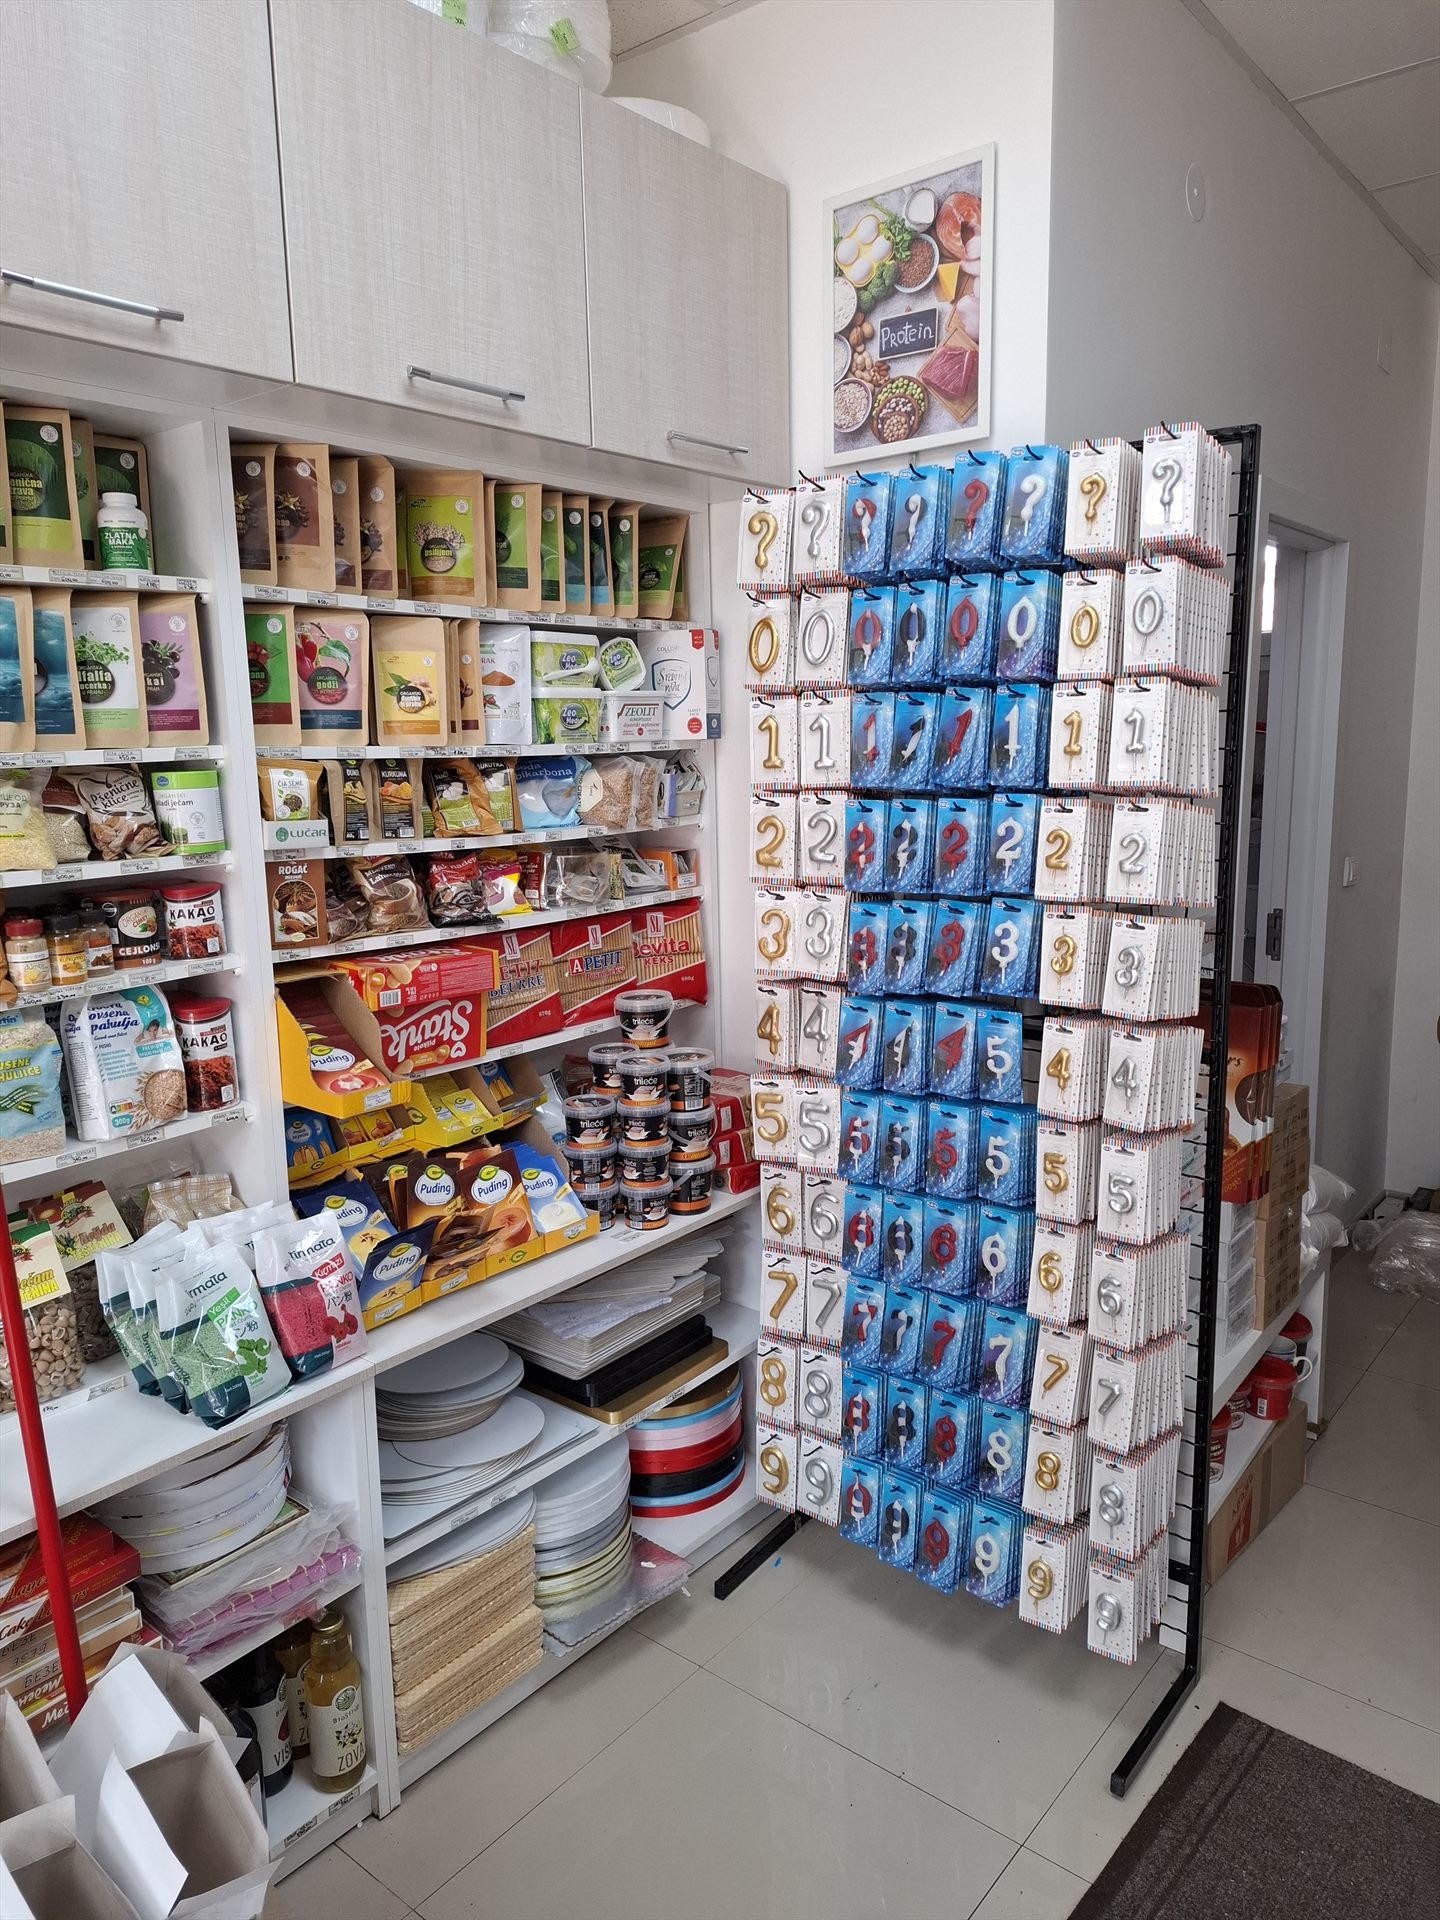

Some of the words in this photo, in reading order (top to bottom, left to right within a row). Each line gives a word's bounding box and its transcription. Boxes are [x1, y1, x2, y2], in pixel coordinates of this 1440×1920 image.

[104, 532, 138, 541] ZLATNA
[1007, 598, 1037, 648] 0
[1071, 604, 1099, 649] 0
[1133, 588, 1164, 635] 0
[561, 653, 577, 663] Zeo
[750, 616, 780, 673] 0
[802, 610, 835, 666] 0
[562, 708, 577, 718] Zeo
[624, 706, 658, 717] ZEOLIT
[1004, 704, 1022, 754] 1
[1124, 707, 1146, 754] 1
[758, 714, 783, 769] 1
[809, 713, 835, 769] 1
[1063, 710, 1082, 755] 1
[90, 779, 140, 806] Pšenične
[101, 793, 129, 810] klice
[756, 816, 785, 867] 2
[808, 811, 837, 863] 2
[996, 818, 1025, 860] 2
[1045, 827, 1071, 870] 2
[1119, 833, 1147, 874] 2
[278, 863, 309, 875] ROGAČ
[169, 905, 216, 921] KAKAO
[649, 914, 663, 934] SL
[806, 906, 834, 959] 3
[505, 936, 519, 955] SL
[589, 926, 600, 946] SL
[758, 908, 790, 960] 3
[992, 921, 1019, 962] 3
[1050, 934, 1077, 975] 3
[571, 951, 622, 975] APETIT
[644, 955, 675, 967] KEKS
[1115, 946, 1142, 987] 3
[88, 1009, 130, 1022] ovsena
[90, 1017, 140, 1036] pahulja
[757, 1003, 782, 1054] 4
[804, 1001, 830, 1054] 4
[181, 1032, 228, 1049] KAKAO
[311, 1054, 350, 1068] Puding
[986, 1036, 1013, 1075] 5
[1046, 1048, 1070, 1089] 4
[1112, 1057, 1138, 1098] 4
[755, 1093, 787, 1144] 5
[799, 1101, 831, 1151] 5
[985, 1136, 1011, 1176] 5
[1043, 1152, 1068, 1194] 5
[420, 1183, 452, 1196] Puding
[477, 1178, 508, 1198] Puding
[524, 1177, 554, 1193] Puding
[1108, 1173, 1133, 1214] 5
[766, 1185, 795, 1236] 6
[810, 1191, 839, 1241] 6
[378, 1253, 418, 1275] Puding
[982, 1233, 1008, 1274] 6
[1038, 1252, 1061, 1292] 6
[768, 1271, 798, 1319] 7
[813, 1278, 841, 1327] 7
[1099, 1275, 1122, 1315] 6
[988, 1335, 1012, 1381] 7
[1044, 1353, 1069, 1391] 7
[760, 1358, 787, 1406] 8
[804, 1368, 833, 1419] 8
[1099, 1378, 1121, 1416] 7
[761, 1446, 789, 1494] 9
[987, 1429, 1012, 1472] 8
[805, 1458, 833, 1506] 9
[1035, 1451, 1061, 1492] 8
[1099, 1483, 1125, 1525] 8
[974, 1532, 1000, 1574] 9
[1028, 1558, 1053, 1600] 9
[1096, 1592, 1122, 1632] 9
[338, 1743, 365, 1773] ZOVA
